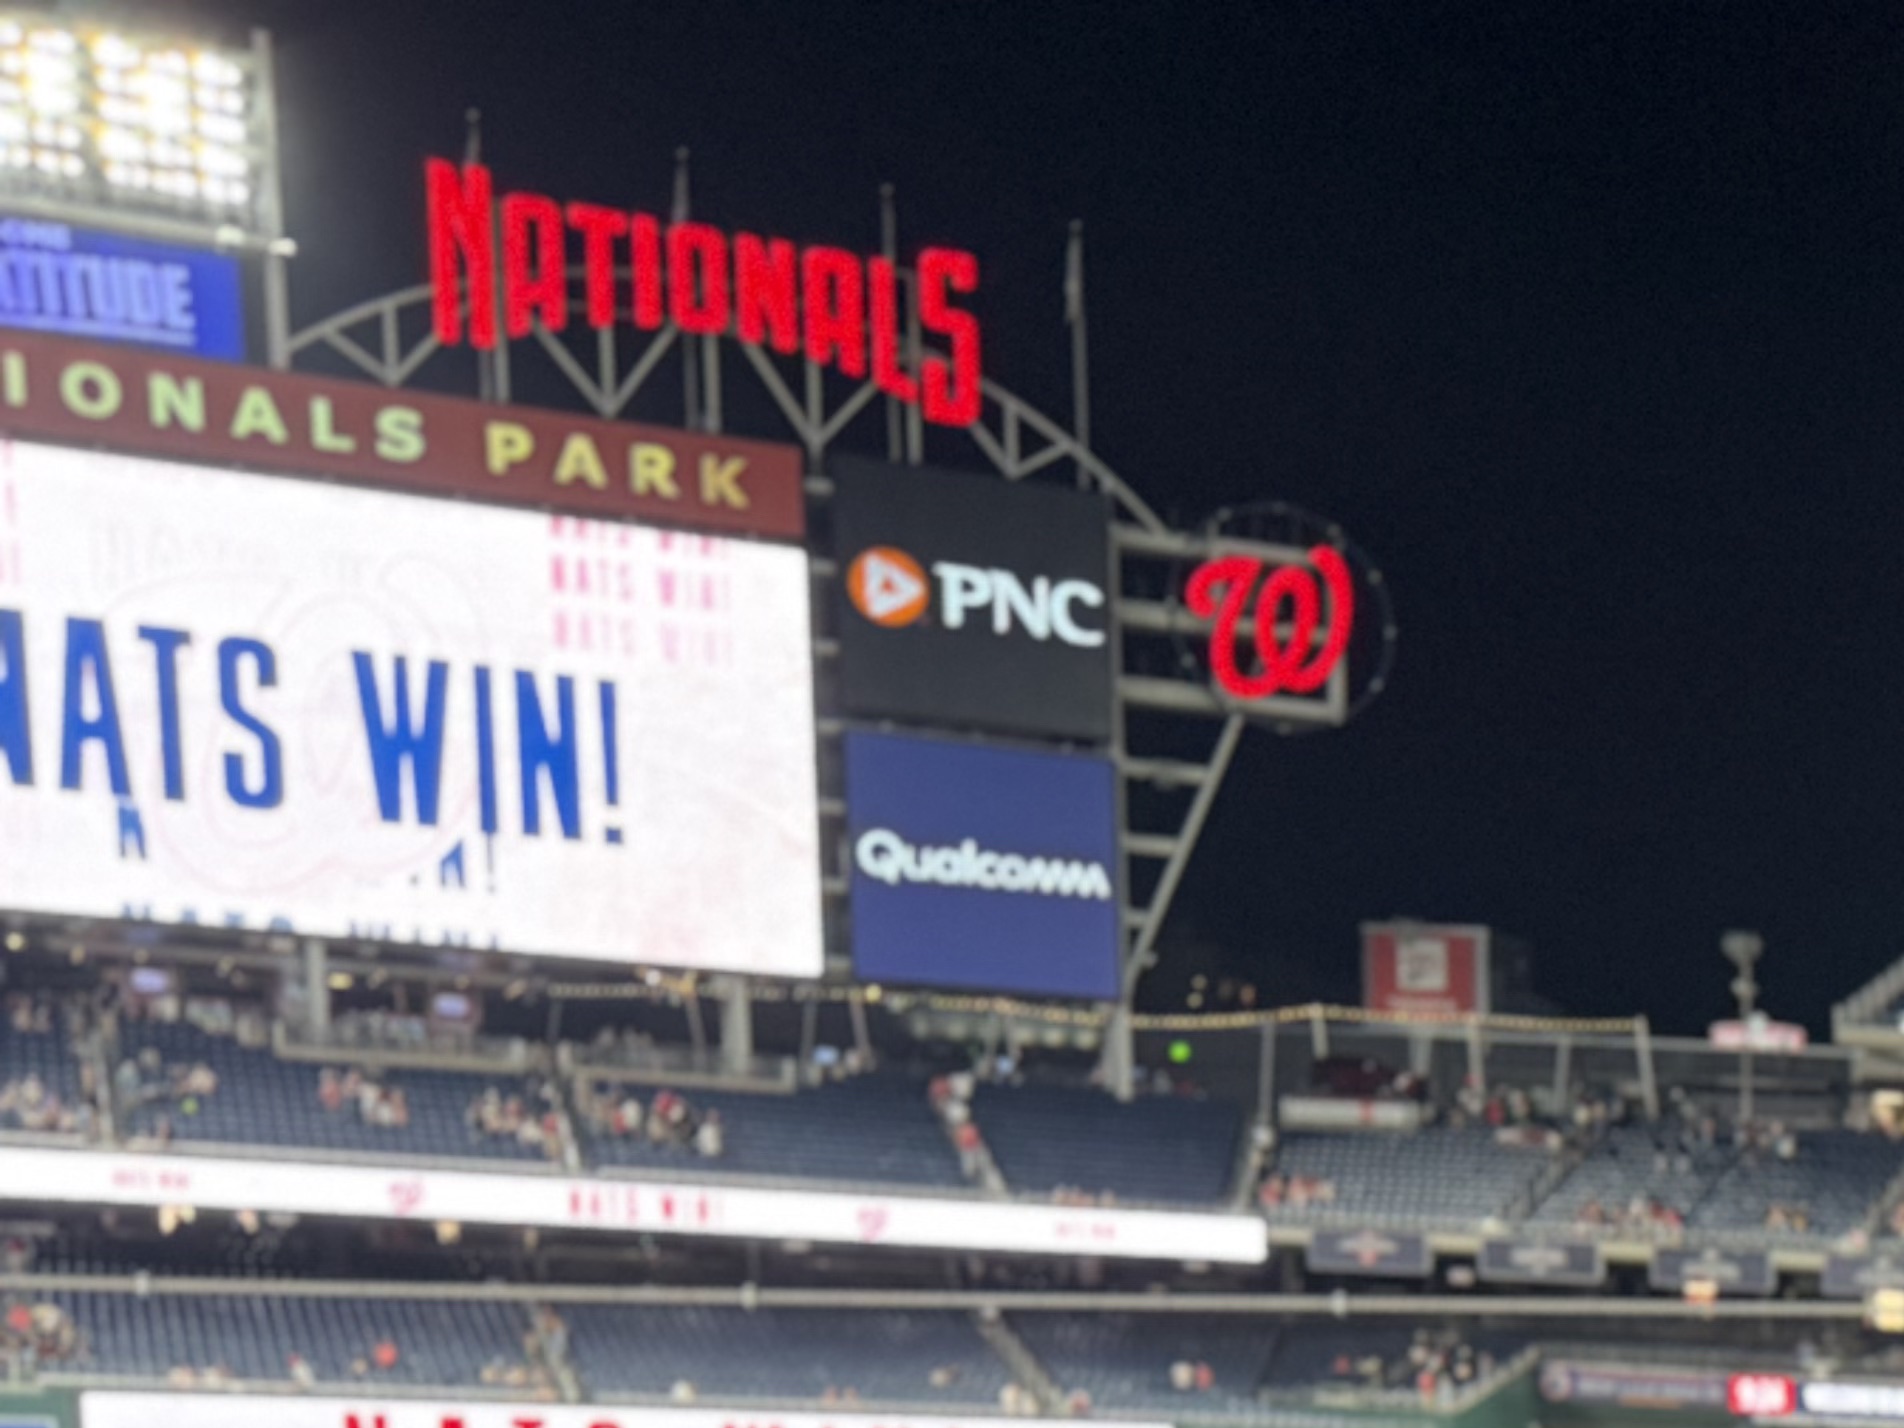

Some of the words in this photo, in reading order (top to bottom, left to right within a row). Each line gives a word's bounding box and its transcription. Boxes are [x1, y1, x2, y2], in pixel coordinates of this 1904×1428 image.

[425, 157, 982, 428] NATIONALS
[486, 420, 751, 509] PARK
[932, 560, 1105, 647] PNC
[1185, 544, 1355, 699] W
[351, 651, 624, 844] WIN!
[855, 828, 1112, 899] Qualcomm
